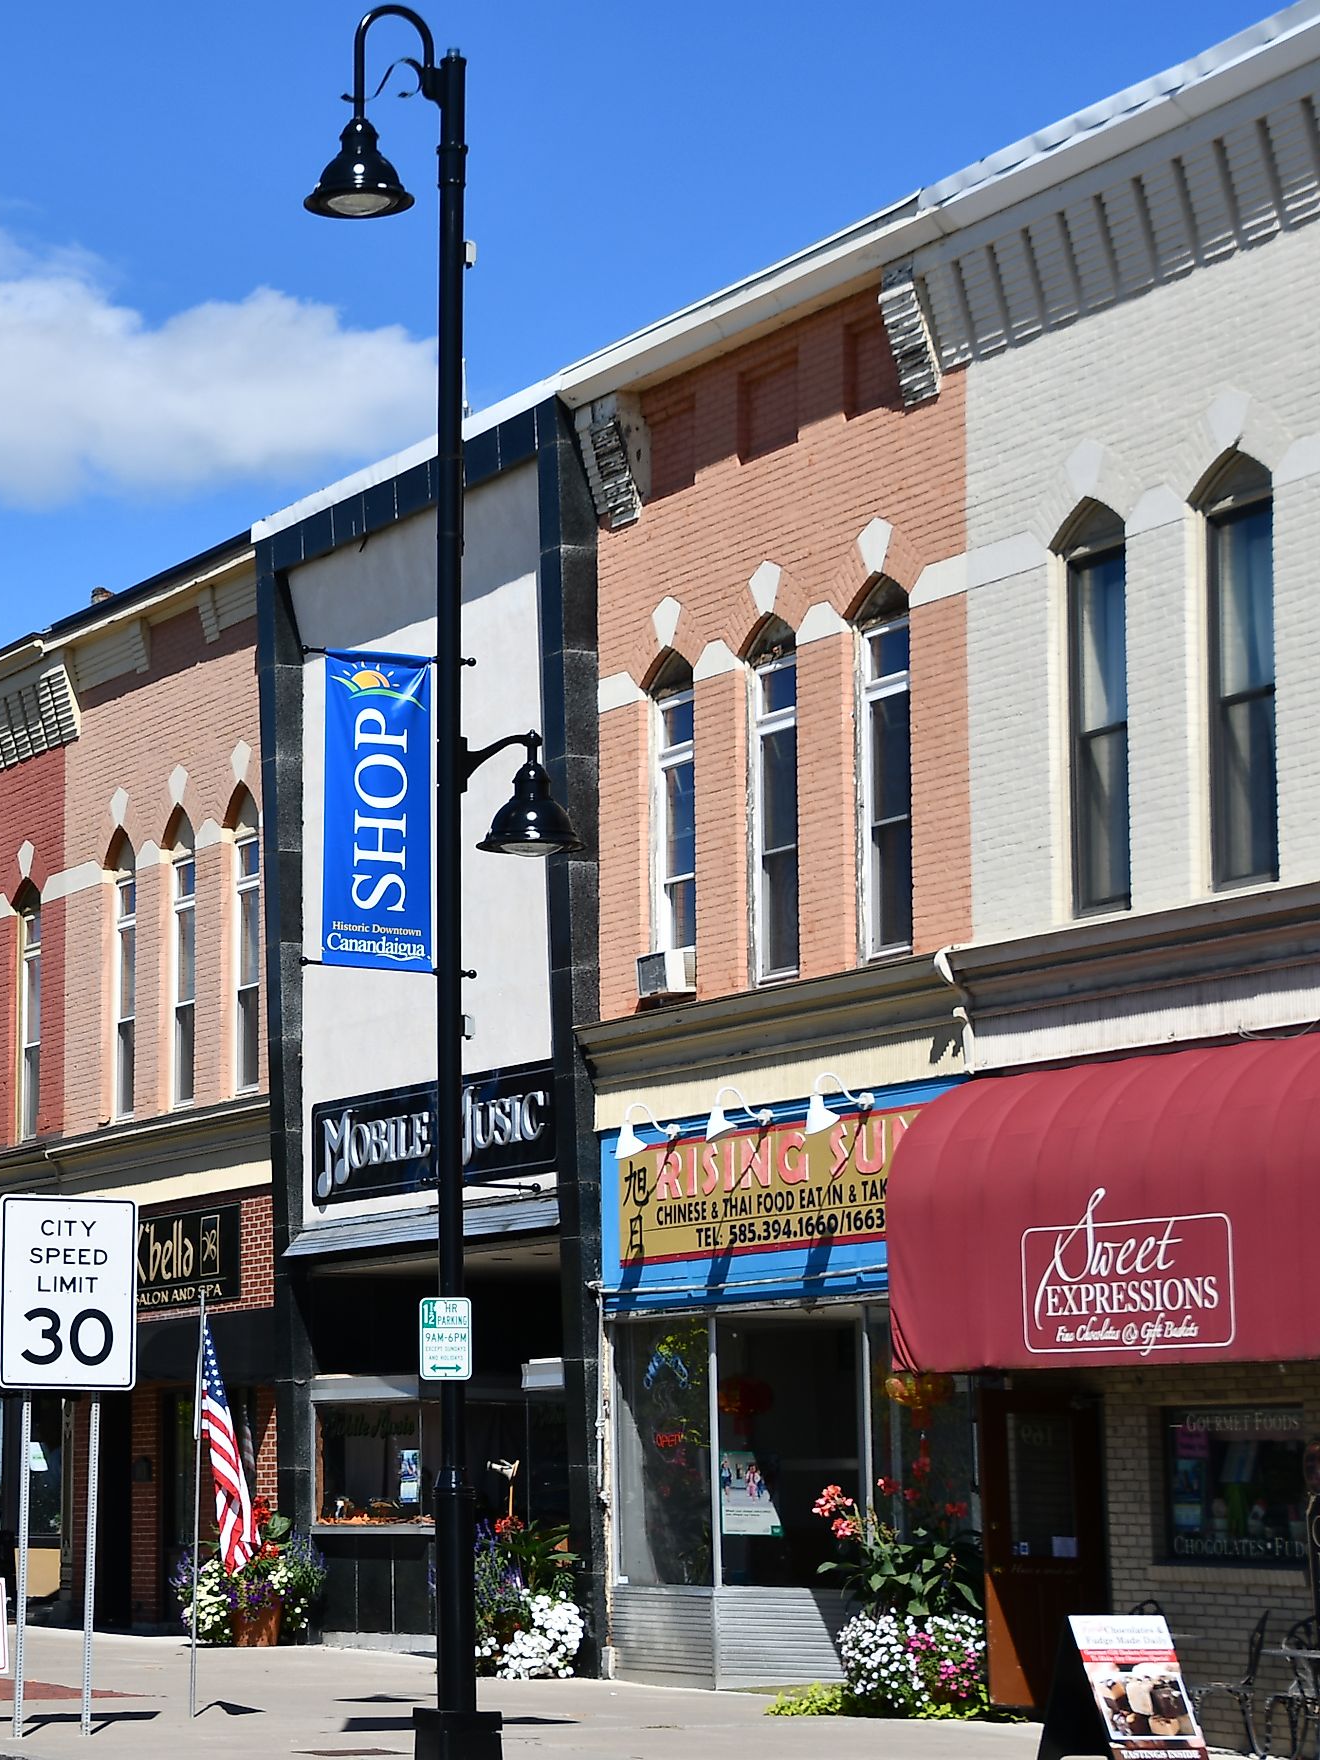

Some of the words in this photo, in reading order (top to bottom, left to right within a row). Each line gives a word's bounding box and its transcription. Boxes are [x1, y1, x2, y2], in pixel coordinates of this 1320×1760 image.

[351, 706, 409, 912] SHOP
[332, 920, 370, 933] Historic
[371, 923, 422, 937] Downtown
[326, 932, 426, 958] Canandaigua
[655, 1130, 810, 1201] RISING
[656, 1199, 708, 1226] CHINESE
[711, 1201, 719, 1219] &
[723, 1195, 754, 1218] THAI
[757, 1190, 796, 1214] FOOD
[799, 1185, 824, 1209] EAT
[827, 1184, 844, 1205] IN
[847, 1184, 858, 1203] &
[40, 1219, 97, 1237] CITY
[729, 1206, 886, 1246] 585.394.1660/1663
[29, 1247, 108, 1266] SPEED
[1034, 1187, 1184, 1330] Sweet
[37, 1275, 98, 1294] LIMIT
[171, 1286, 196, 1303] AND
[197, 1283, 223, 1299] SPA
[1045, 1275, 1220, 1317] EXPRESSIONS
[445, 1303, 458, 1314] HR
[437, 1315, 468, 1326] PARKING
[21, 1307, 114, 1366] 30
[424, 1332, 468, 1343] 9AM-6PM
[1140, 1312, 1166, 1357] Gift
[1185, 1413, 1251, 1433] GOURMET
[1254, 1411, 1301, 1432] FOODS
[1173, 1534, 1265, 1556] CHOCOLATES
